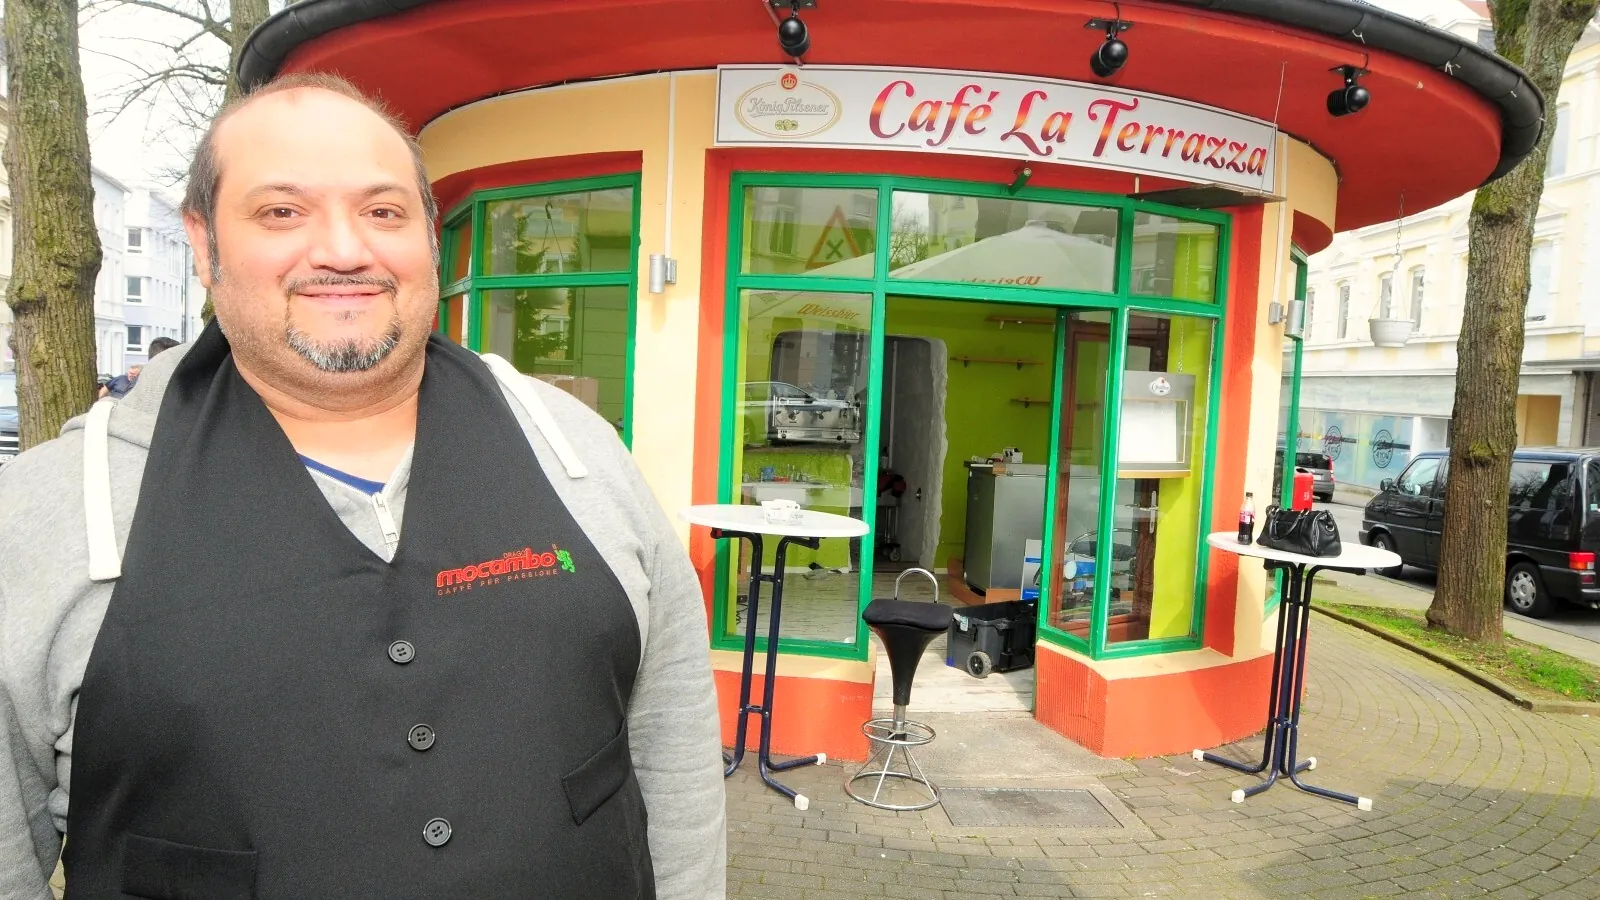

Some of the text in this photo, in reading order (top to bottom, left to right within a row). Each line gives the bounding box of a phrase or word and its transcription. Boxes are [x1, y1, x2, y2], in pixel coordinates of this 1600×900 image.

[747, 97, 829, 115] König Pilsener
[869, 80, 1267, 176] Café La Terrazza
[437, 548, 556, 588] mocambo
[480, 577, 500, 587] PER
